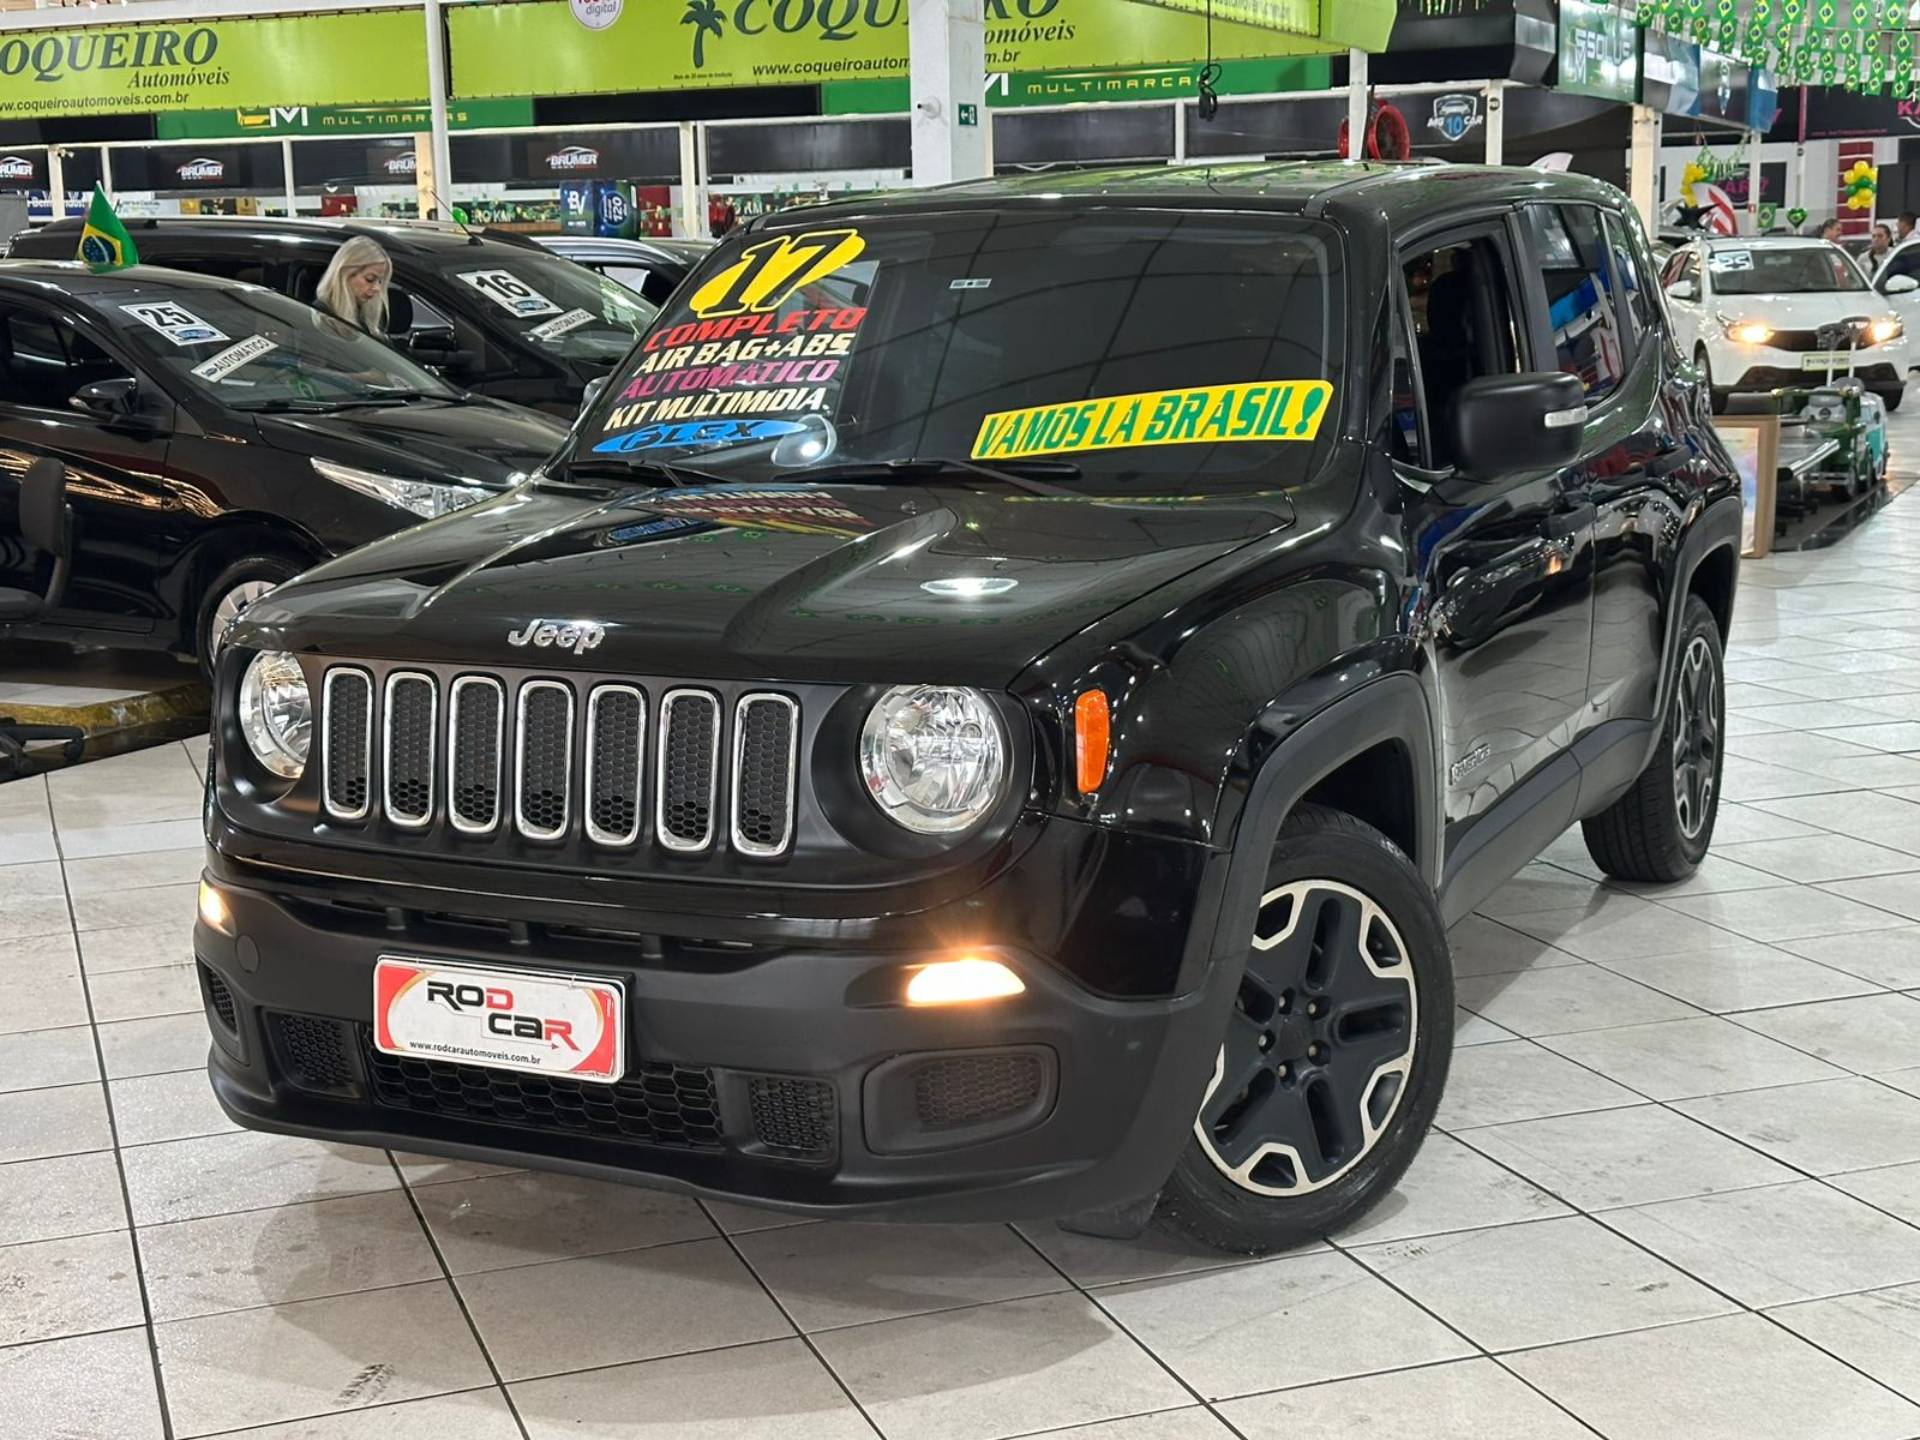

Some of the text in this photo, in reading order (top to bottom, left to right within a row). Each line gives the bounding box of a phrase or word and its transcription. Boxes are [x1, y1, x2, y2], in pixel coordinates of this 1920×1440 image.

[586, 1, 617, 17] digital
[984, 19, 1076, 44] omóveis
[0, 28, 218, 82] OQUEIRO
[128, 66, 230, 89] Automóveis
[1027, 76, 1200, 95] MULTIMARCA
[0, 91, 189, 113] w.coqueiroautomoveis.com.br
[322, 111, 468, 126] MULTIMARAS
[0, 163, 33, 176] RUMER
[694, 228, 862, 318] 17
[474, 274, 531, 299] 16
[138, 306, 195, 327] 25
[643, 306, 868, 353] COMPLETO
[632, 332, 856, 377] AIR BAG+ABS
[602, 401, 657, 432] KIT
[620, 421, 764, 451] FLEX
[977, 403, 1097, 457] VAMOS
[507, 618, 605, 655] Jeep
[427, 980, 514, 1012] ROD
[409, 1040, 541, 1064] www.rodcarautomoveis.com.br
